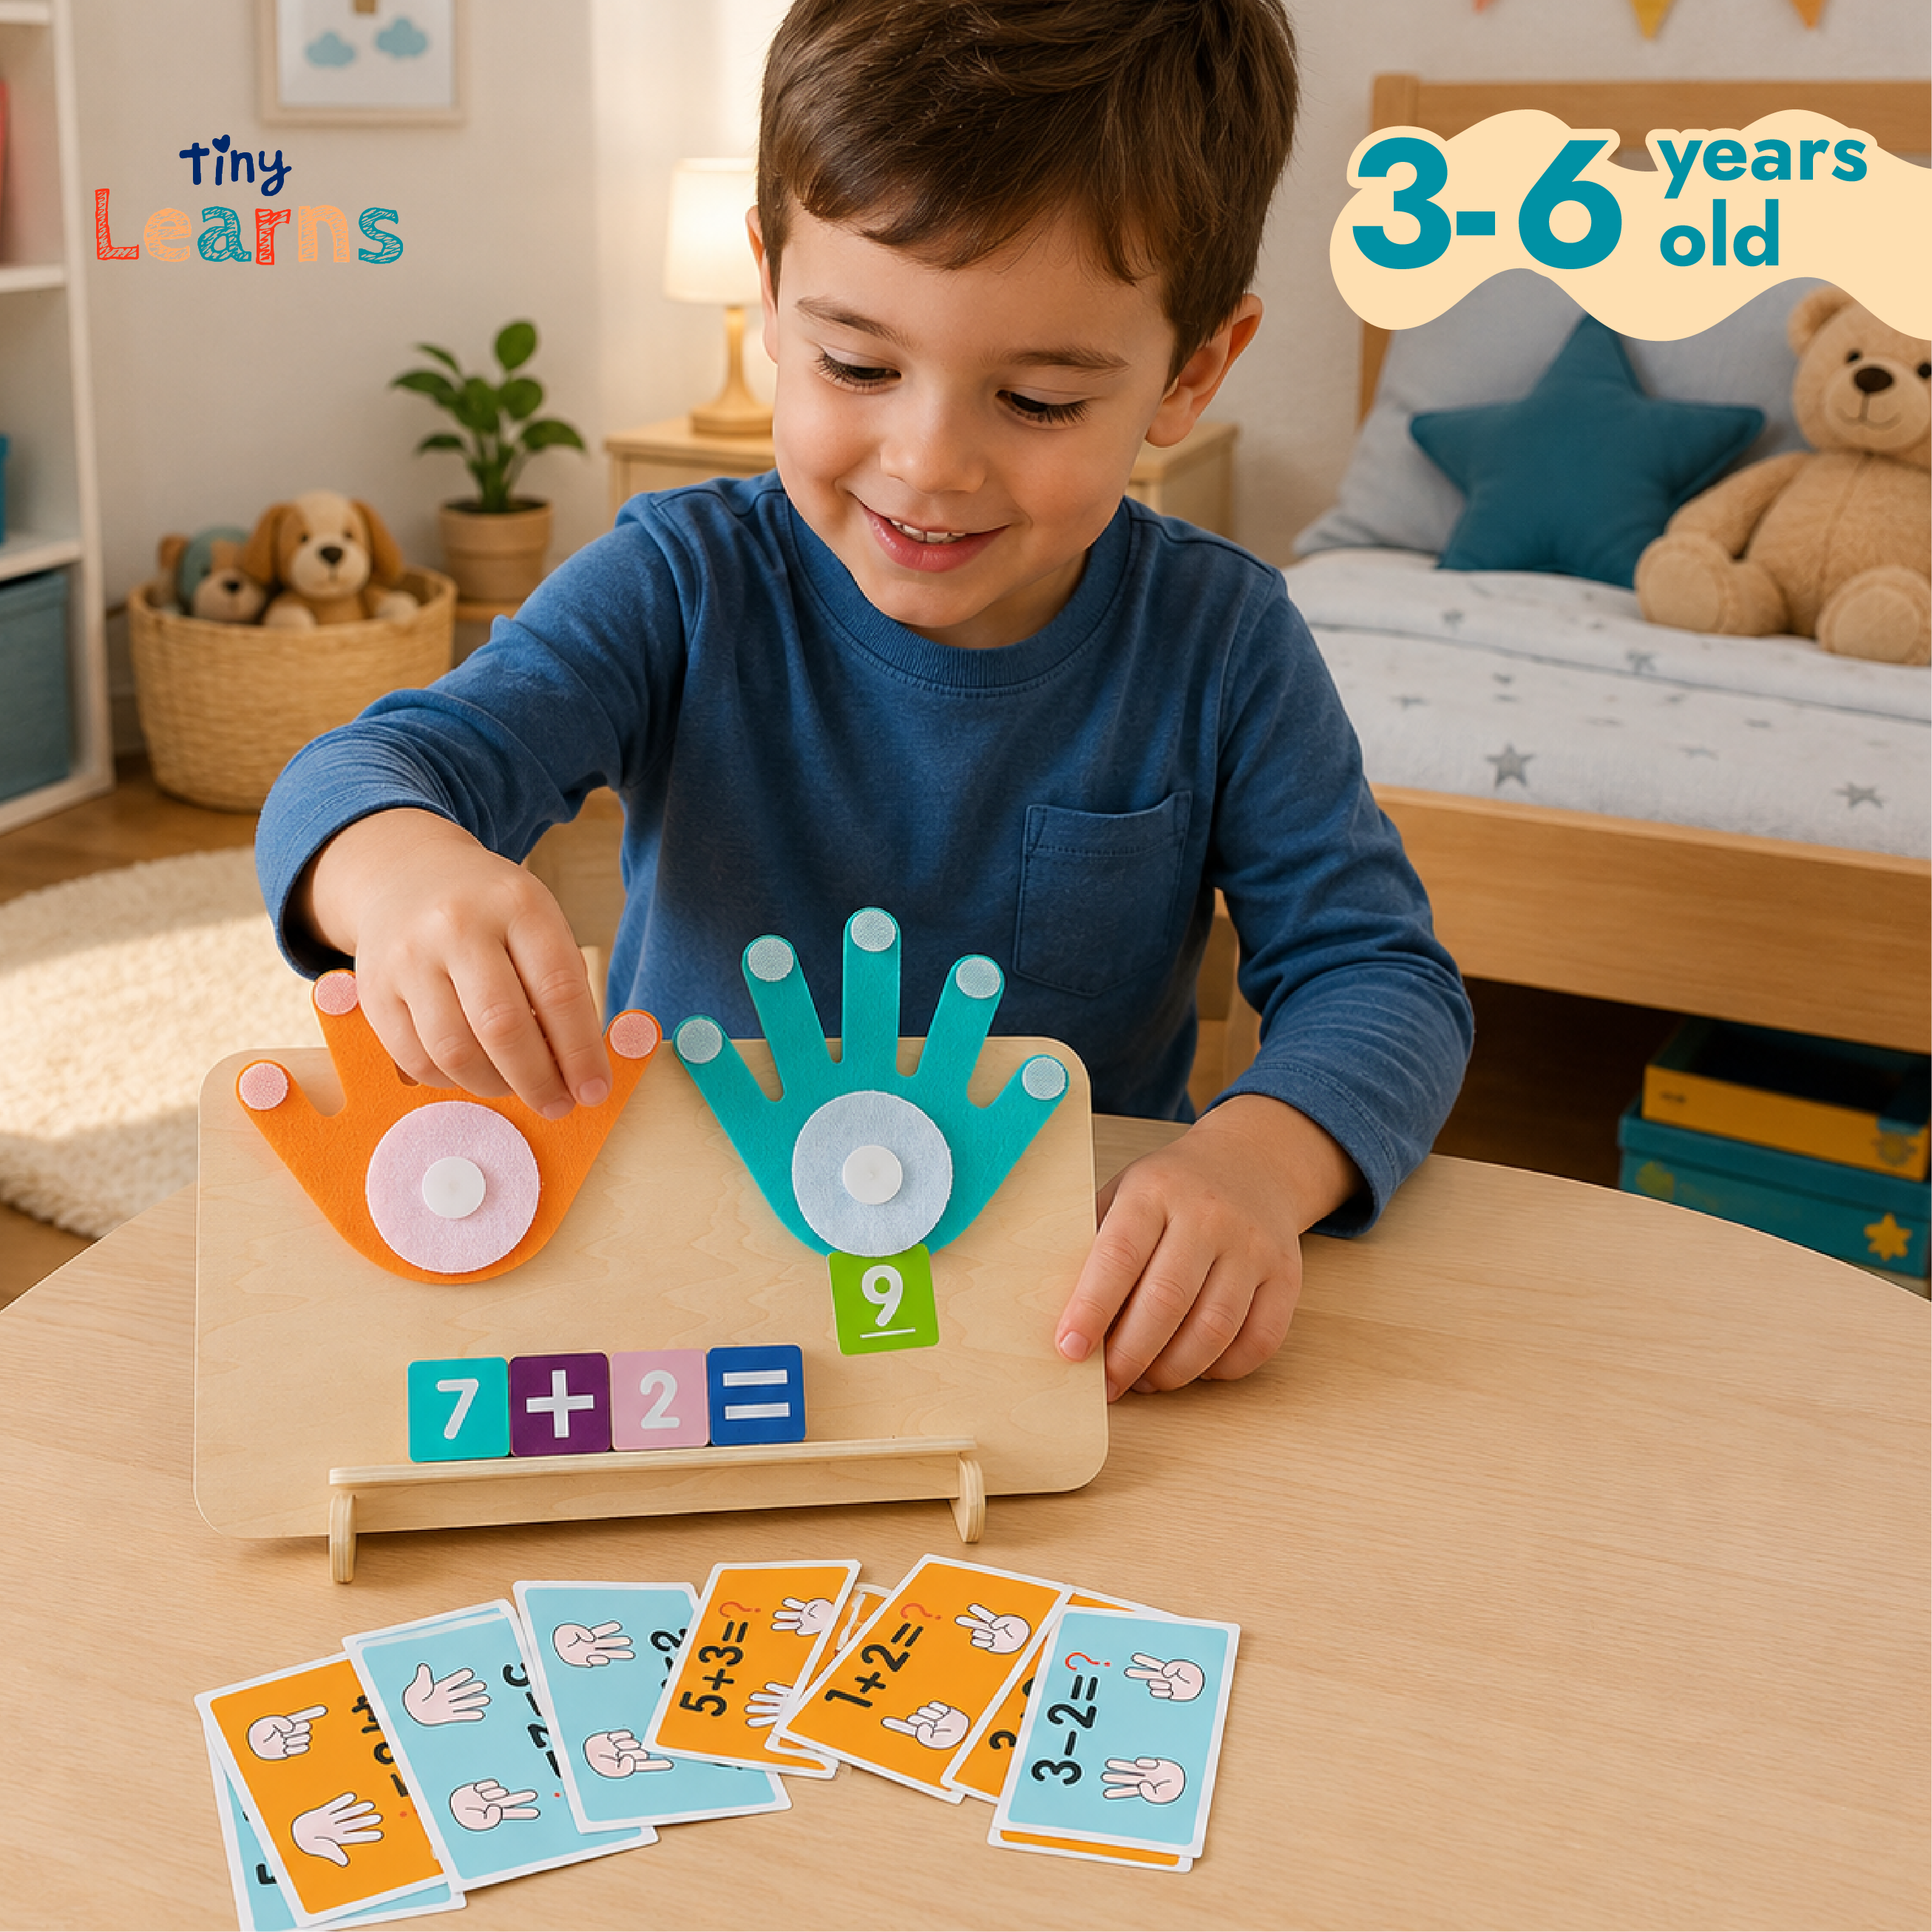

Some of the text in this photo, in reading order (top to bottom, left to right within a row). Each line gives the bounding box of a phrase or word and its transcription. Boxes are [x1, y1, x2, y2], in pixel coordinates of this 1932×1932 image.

[861, 1265, 904, 1327] 9
[679, 1601, 762, 1717] 5+3=?
[824, 1602, 942, 1708] 1+2=?
[1031, 1651, 1111, 1786] 3-2=?
